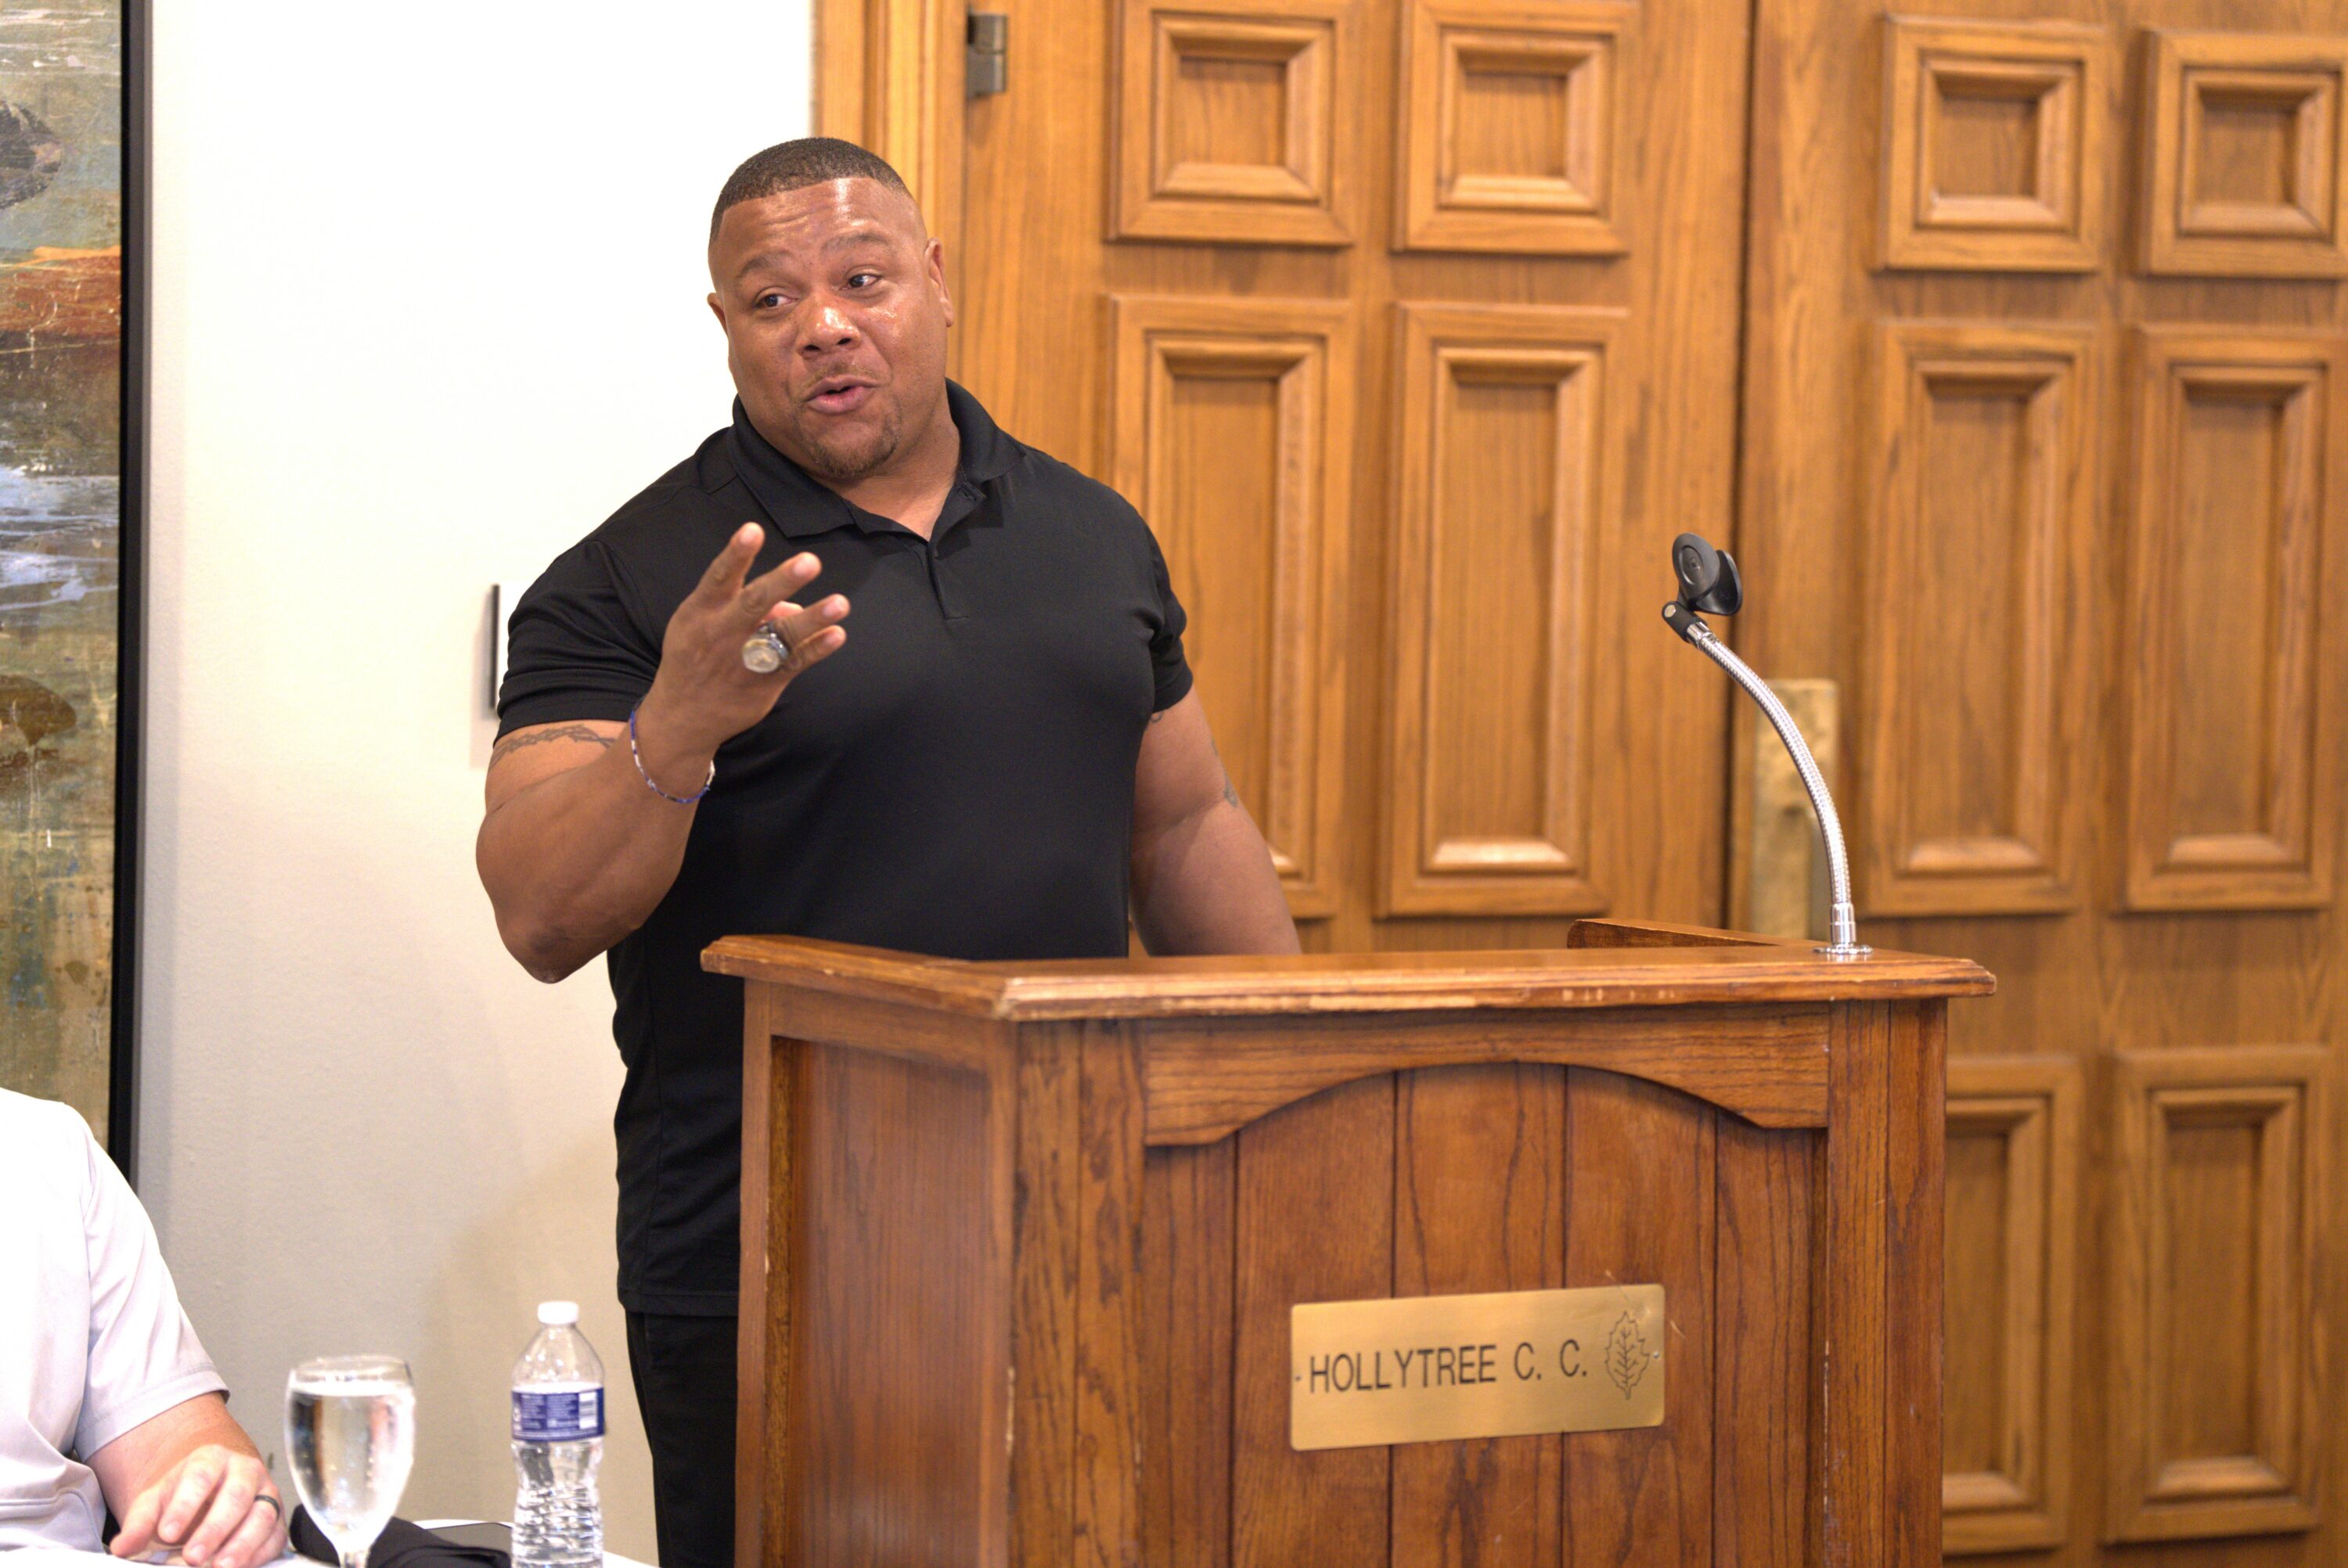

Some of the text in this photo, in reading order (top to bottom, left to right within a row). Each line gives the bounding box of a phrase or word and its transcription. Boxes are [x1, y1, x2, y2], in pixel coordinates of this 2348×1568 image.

[1310, 1340, 1587, 1393] HOLLYTREE C. C.
